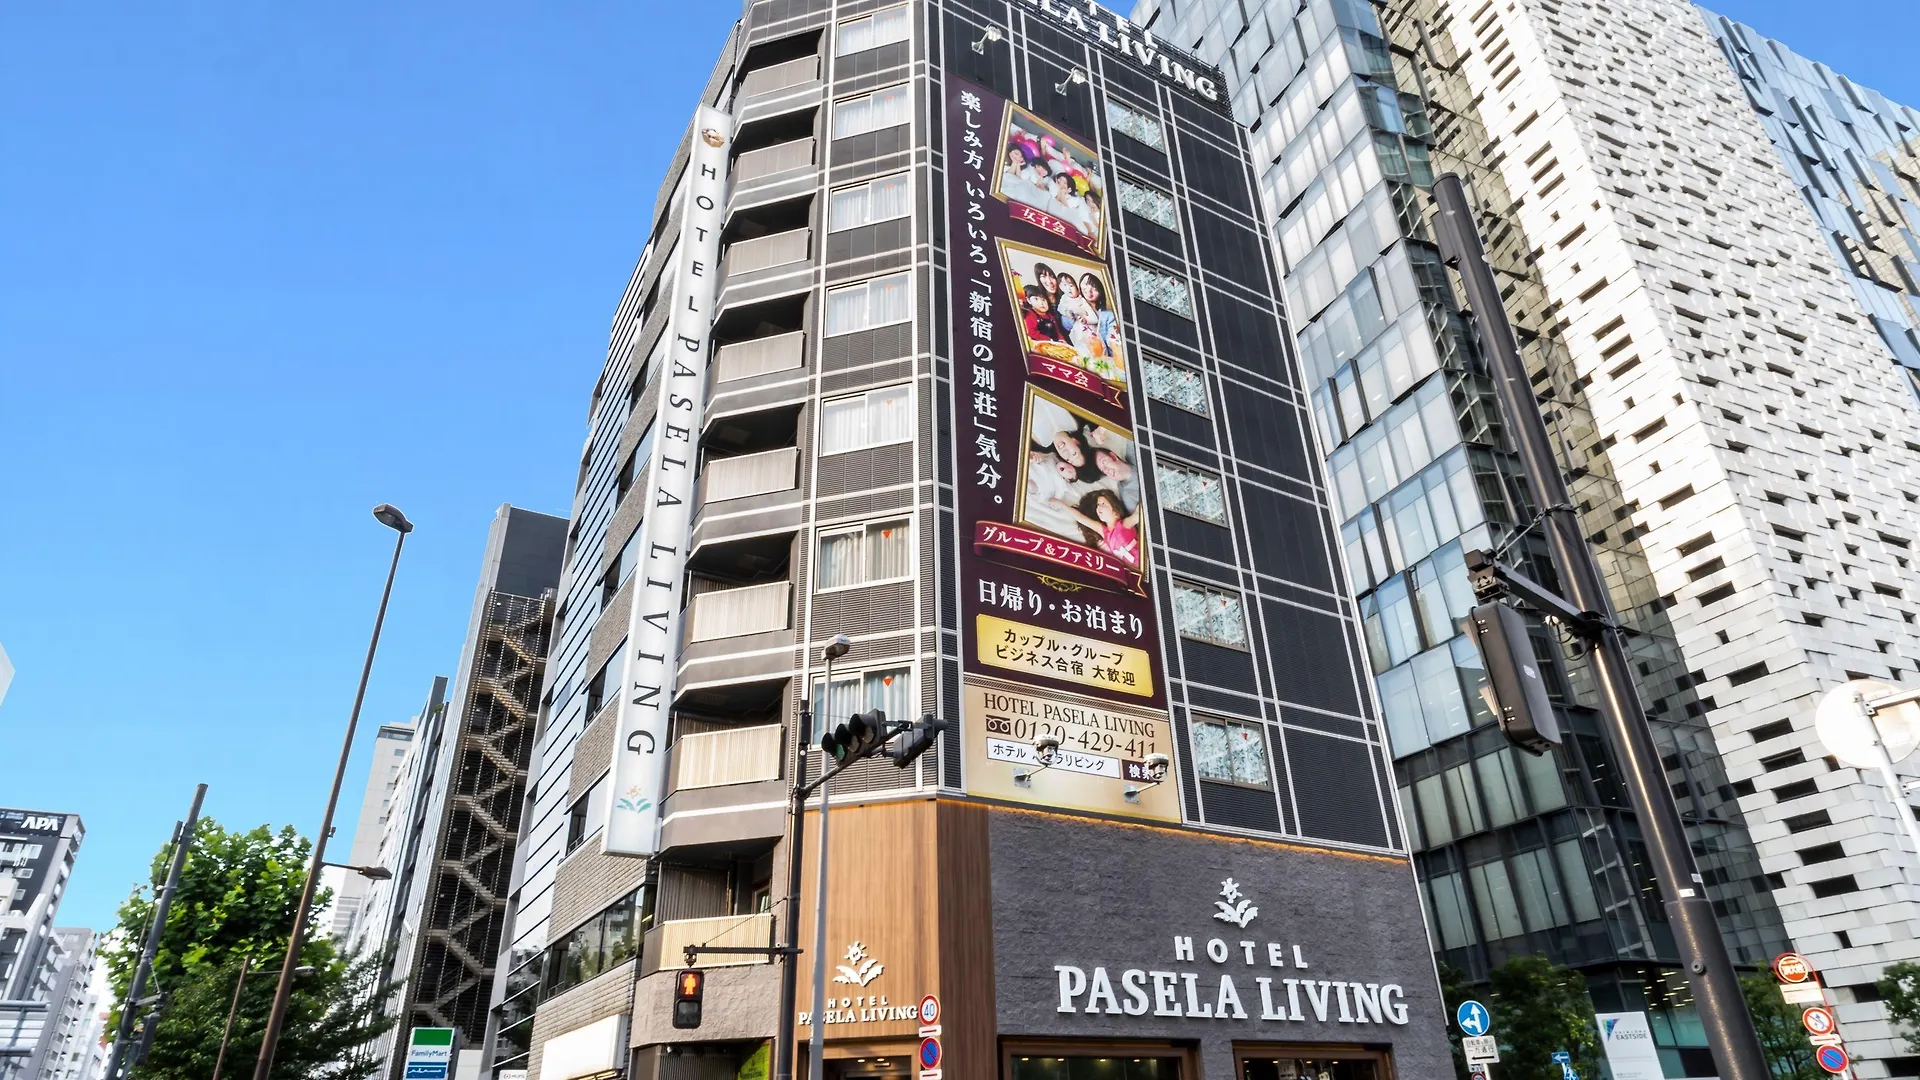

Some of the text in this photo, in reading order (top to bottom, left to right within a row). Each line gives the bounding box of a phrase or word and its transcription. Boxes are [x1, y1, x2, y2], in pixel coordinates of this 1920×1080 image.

[1096, 21, 1218, 101] LIVING
[1021, 208, 1066, 236] 女子会
[960, 90, 1003, 504] 楽しみ方、いろいろ。「新宿の別荘」気分。
[1041, 361, 1089, 388] ママ会
[627, 163, 716, 756] HOTEL PASELA LIVING
[982, 526, 1120, 571] グループ&ファミリー
[979, 578, 1143, 640] 日帰り・お泊まり
[1004, 628, 1124, 666] カップル・グループ
[996, 644, 1136, 687] ビジネス合宿 大歓迎
[984, 692, 1155, 738] HOTEL PASELA LIVING
[993, 743, 1026, 759] ホテル
[21, 816, 58, 831] APA
[1174, 935, 1308, 969] HOTEL
[828, 994, 888, 1009] HOTEL
[924, 1003, 936, 1017] 40
[1053, 965, 1409, 1025] PASELA LIVING
[798, 1005, 918, 1025] PAELA LIVING
[411, 1050, 448, 1058] FamilyMart
